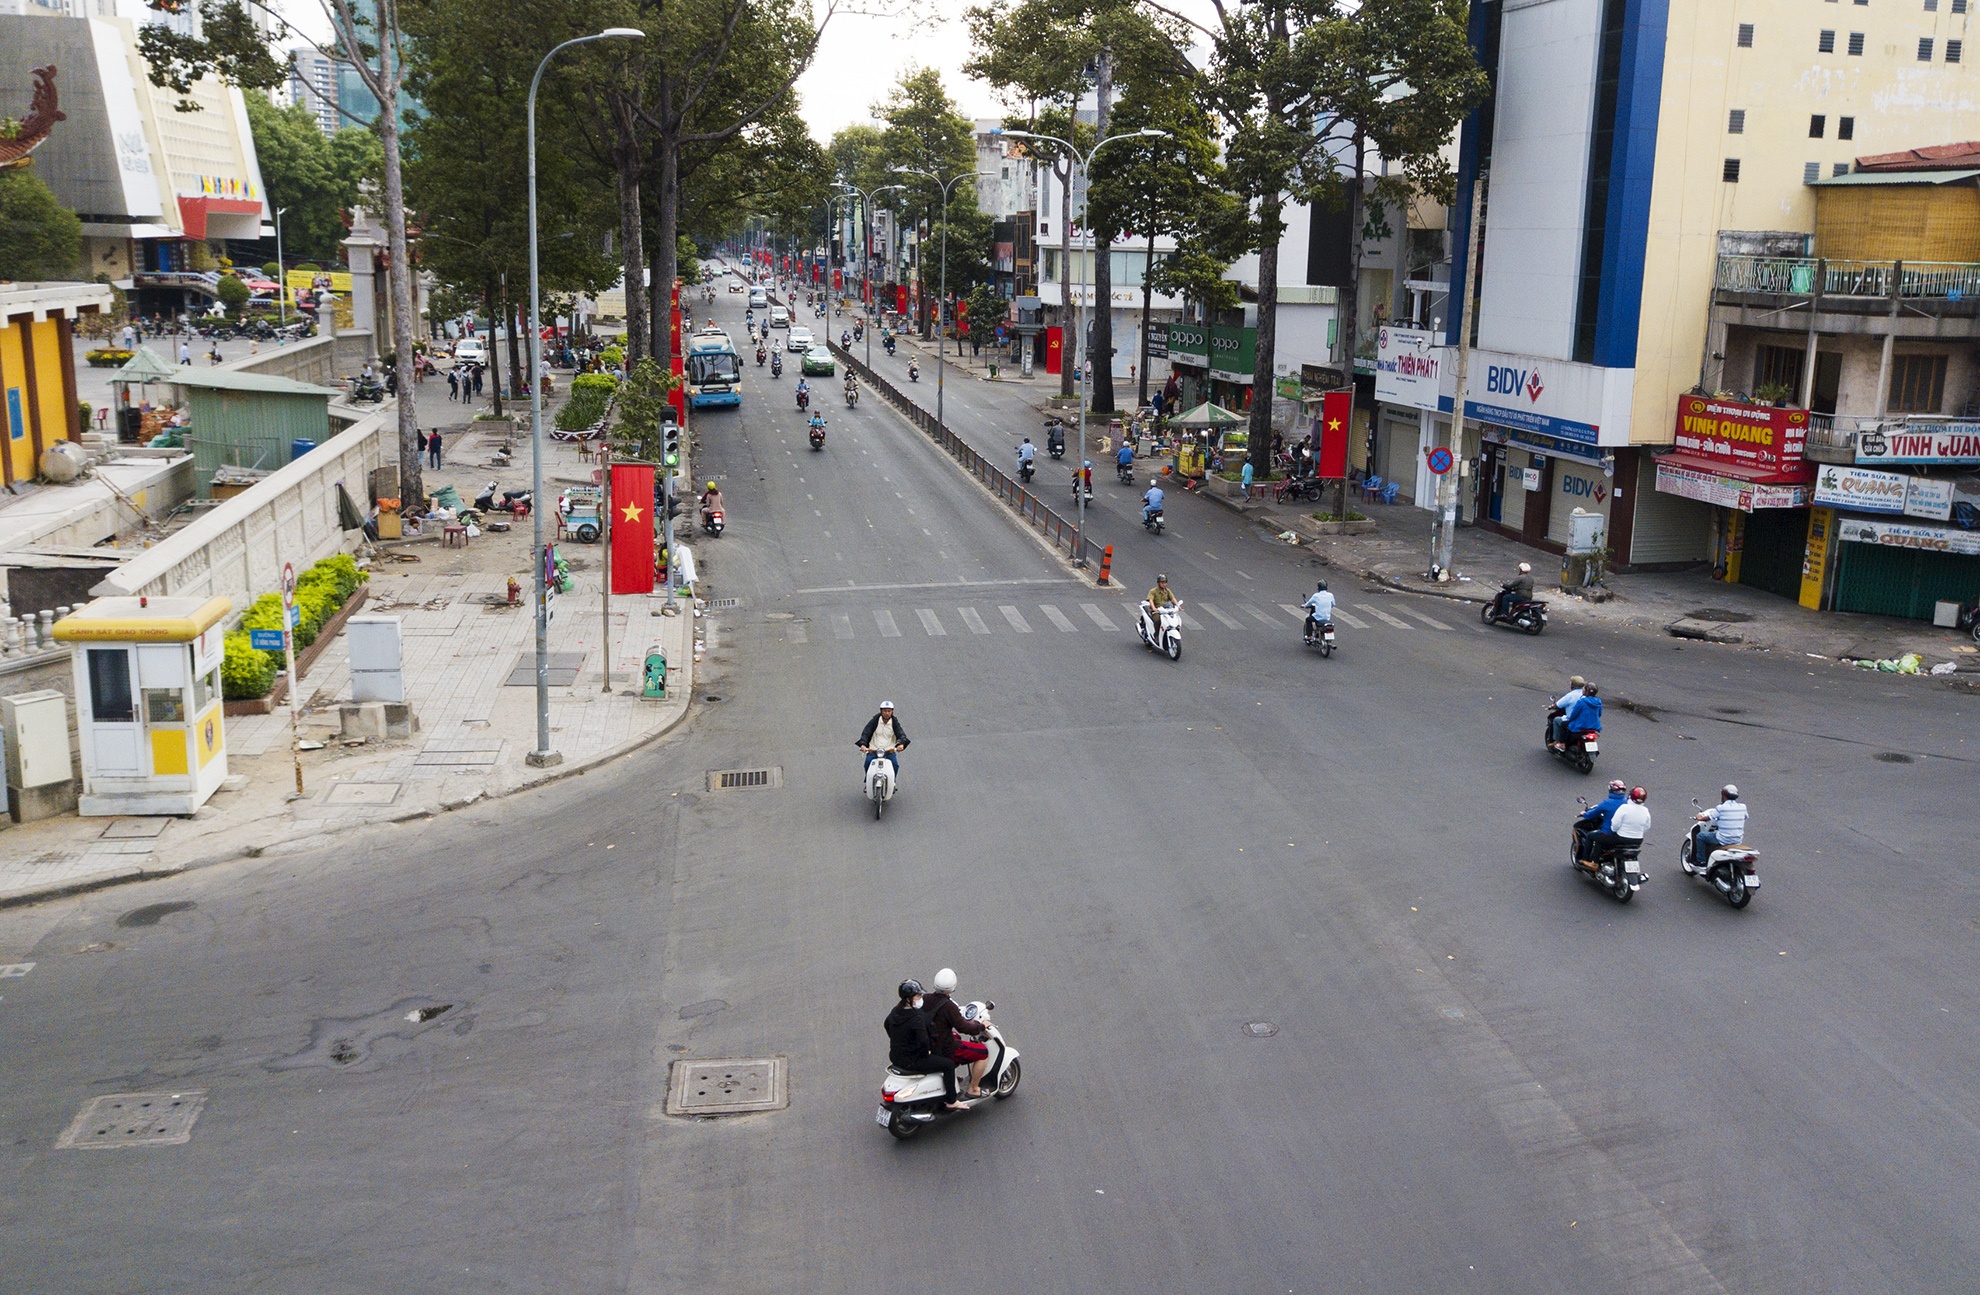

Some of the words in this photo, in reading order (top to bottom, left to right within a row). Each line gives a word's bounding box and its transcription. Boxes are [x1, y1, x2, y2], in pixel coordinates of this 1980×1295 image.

[1487, 365, 1527, 397] BIDV
[1683, 415, 1718, 436] VINH
[1720, 420, 1774, 446] QUANG
[1892, 435, 1933, 456] VINH
[1563, 474, 1594, 498] BIDV
[1841, 477, 1904, 499] QUANG
[1880, 533, 1950, 550] QUANG
